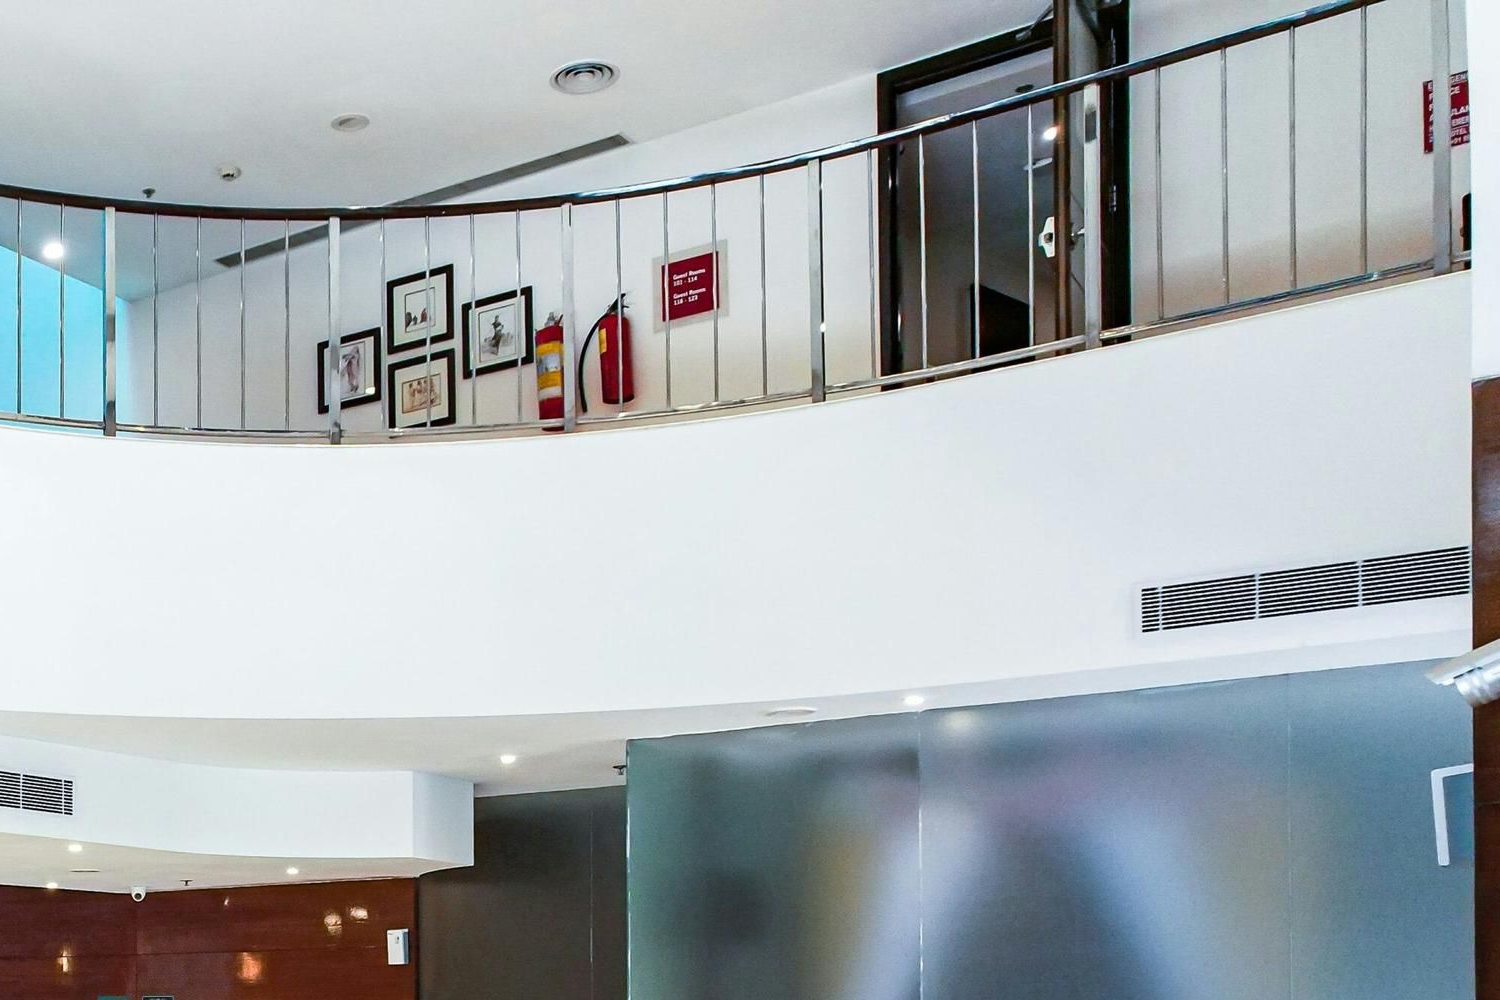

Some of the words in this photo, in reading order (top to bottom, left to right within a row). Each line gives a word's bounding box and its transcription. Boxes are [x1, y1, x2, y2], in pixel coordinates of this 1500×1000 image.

[672, 272, 688, 280] Guest
[688, 268, 706, 276] Rooms
[673, 292, 688, 300] Guest
[688, 288, 706, 296] Rooms
